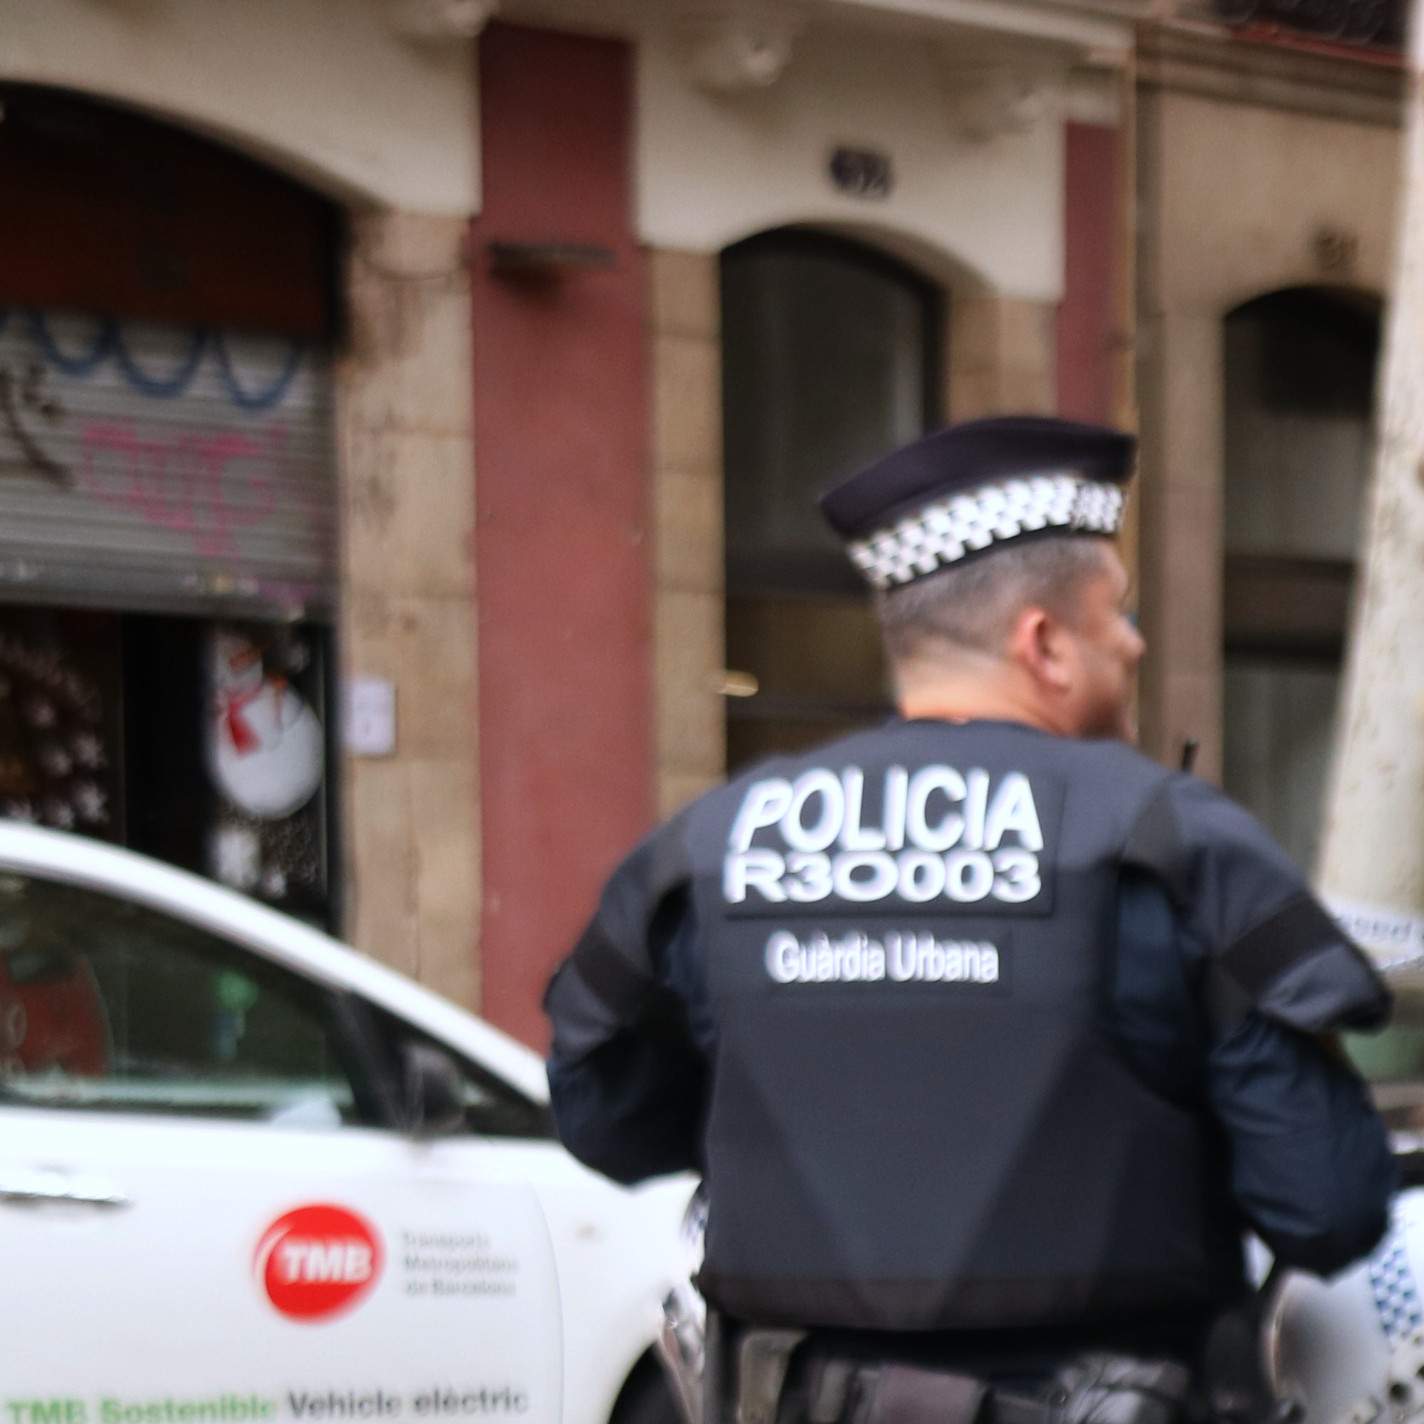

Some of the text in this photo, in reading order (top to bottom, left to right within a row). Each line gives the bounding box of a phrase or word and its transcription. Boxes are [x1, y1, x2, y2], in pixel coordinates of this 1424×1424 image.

[728, 764, 1045, 854] POLICIA
[724, 848, 1043, 905] R30003
[766, 930, 1000, 984] Guàrdia Urbana
[279, 1239, 374, 1284] TMB
[286, 1388, 401, 1421] Vehicle
